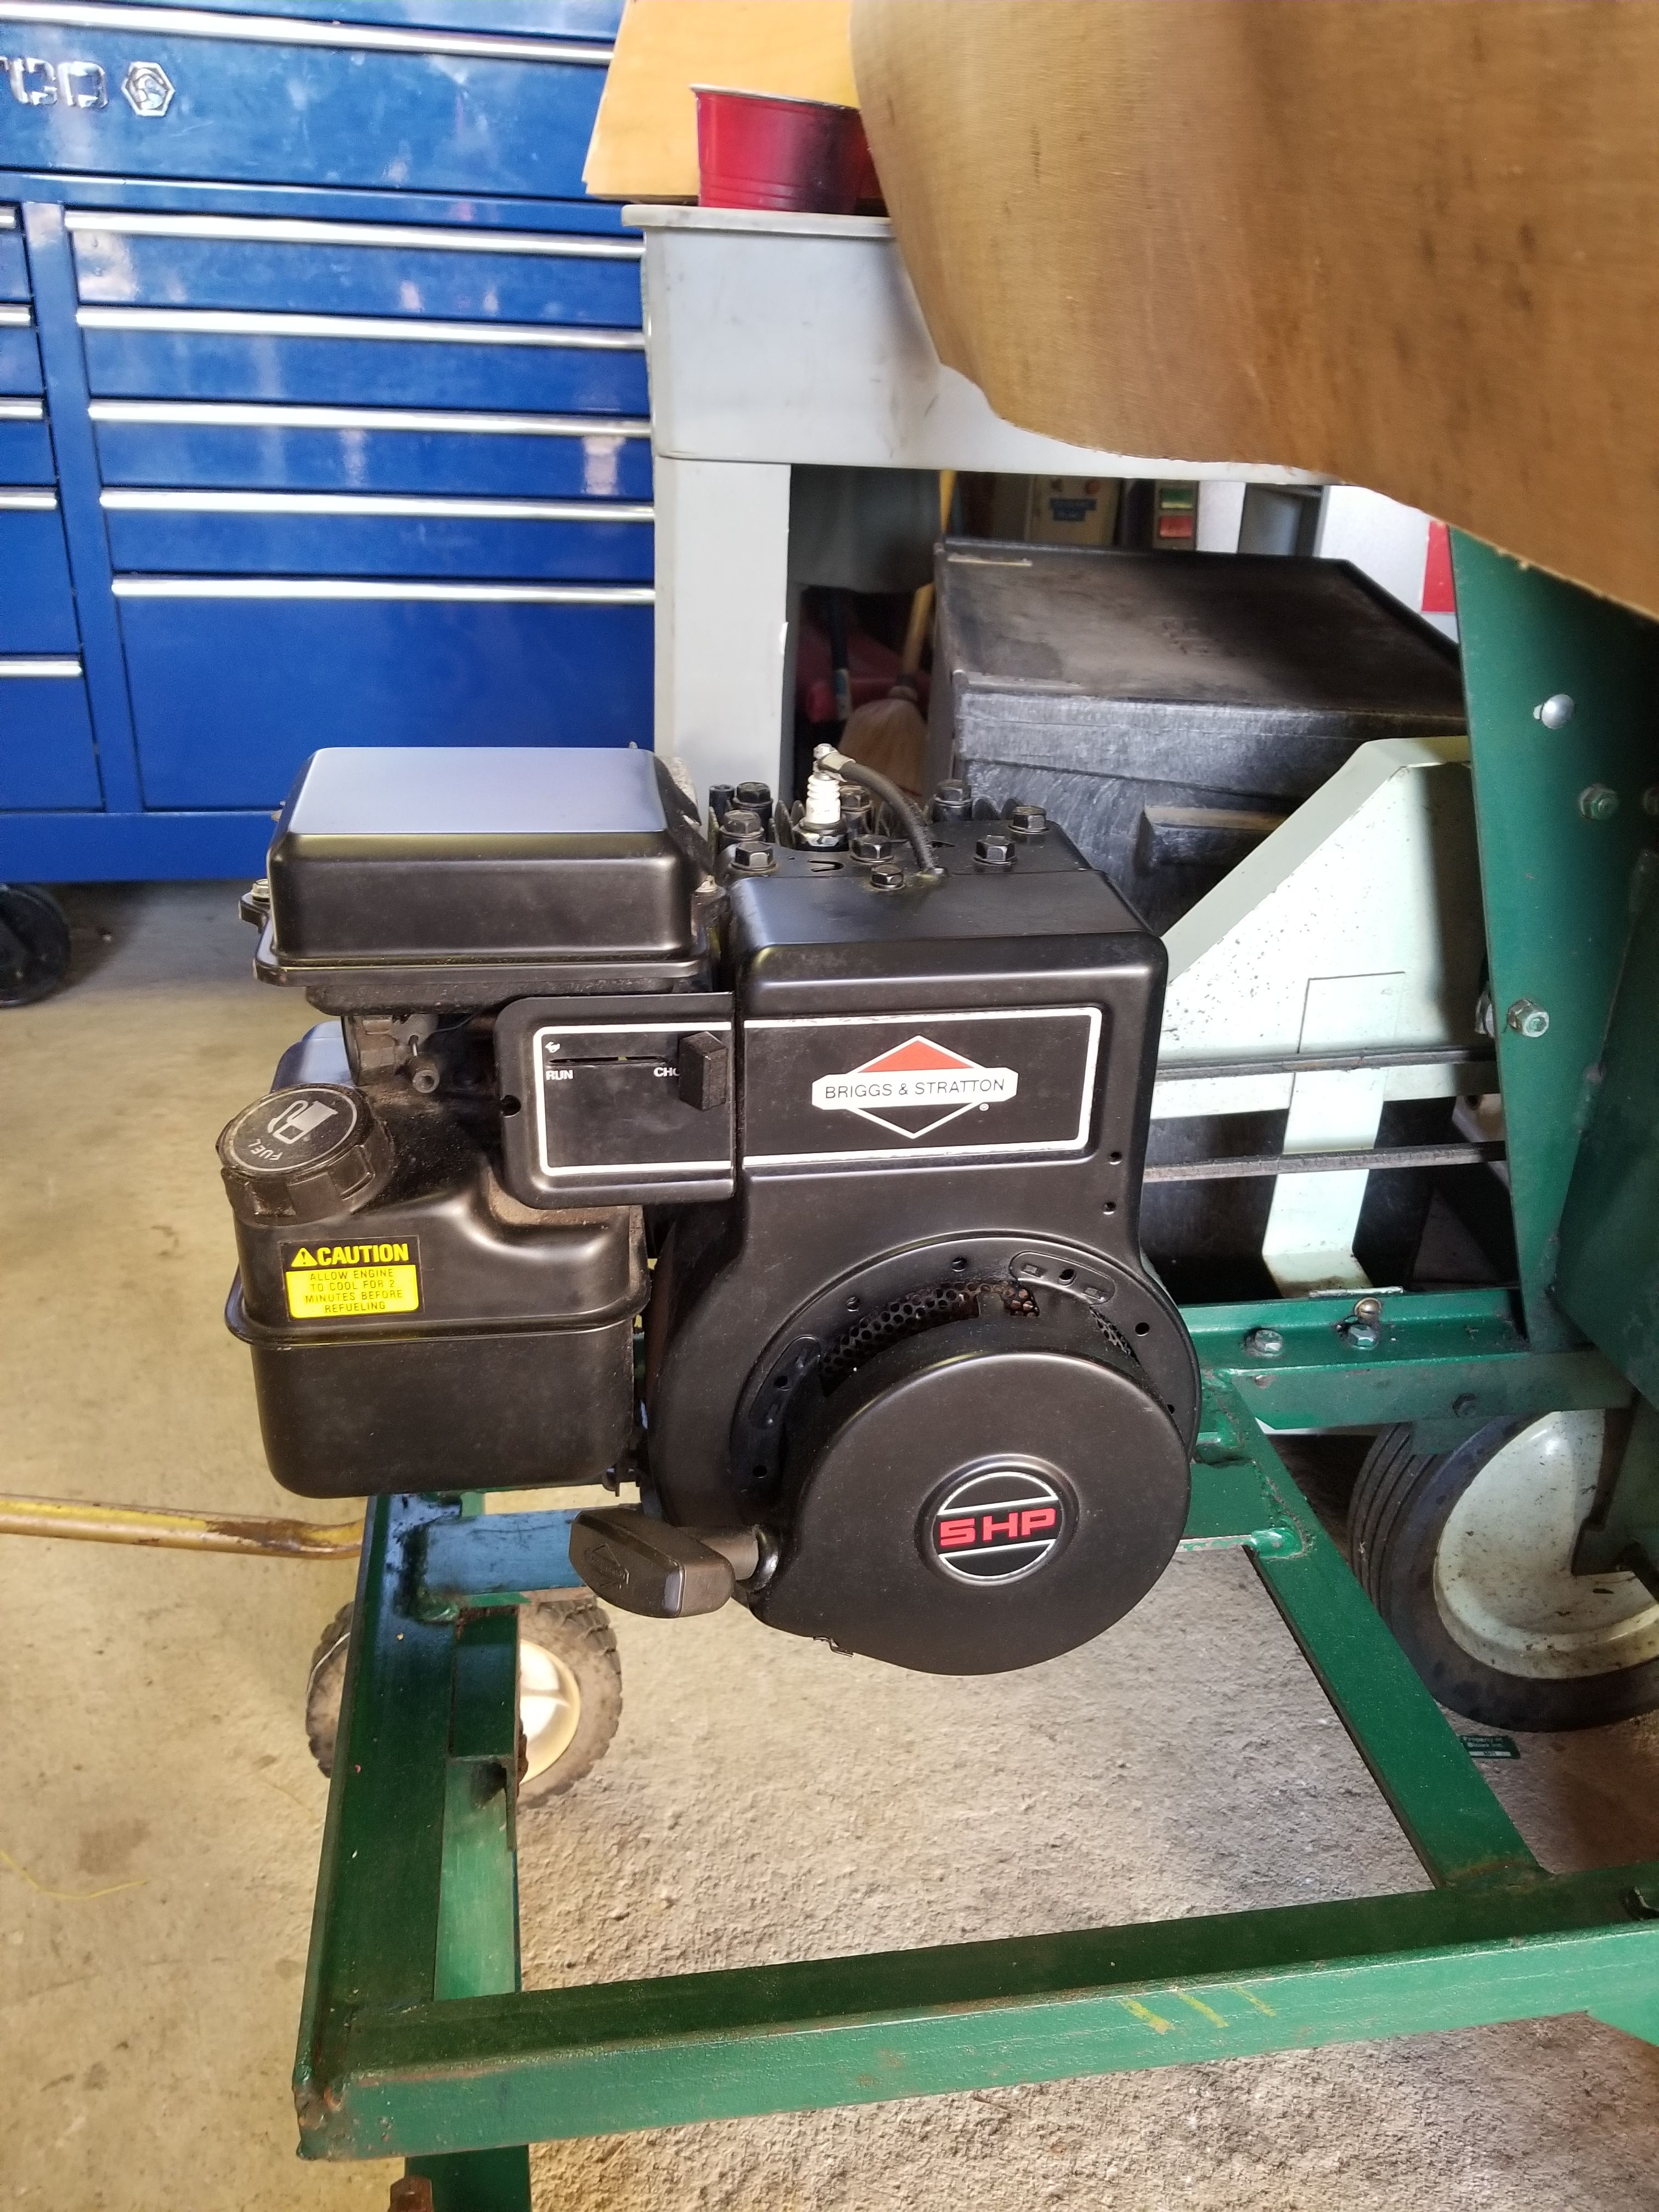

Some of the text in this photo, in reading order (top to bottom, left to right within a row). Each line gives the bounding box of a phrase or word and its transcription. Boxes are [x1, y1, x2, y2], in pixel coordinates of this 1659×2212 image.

[545, 1069, 573, 1081] RUN
[825, 1078, 1005, 1099] BRIGGS & STRATTON
[248, 1138, 283, 1160] FUEL
[317, 1243, 409, 1266] CAUTION
[310, 1268, 394, 1281] ALLOW ENGINE
[311, 1279, 394, 1292] TO COOL FOR 2
[304, 1290, 403, 1304] MINUTES BEFORE
[325, 1301, 386, 1313] REFUELING
